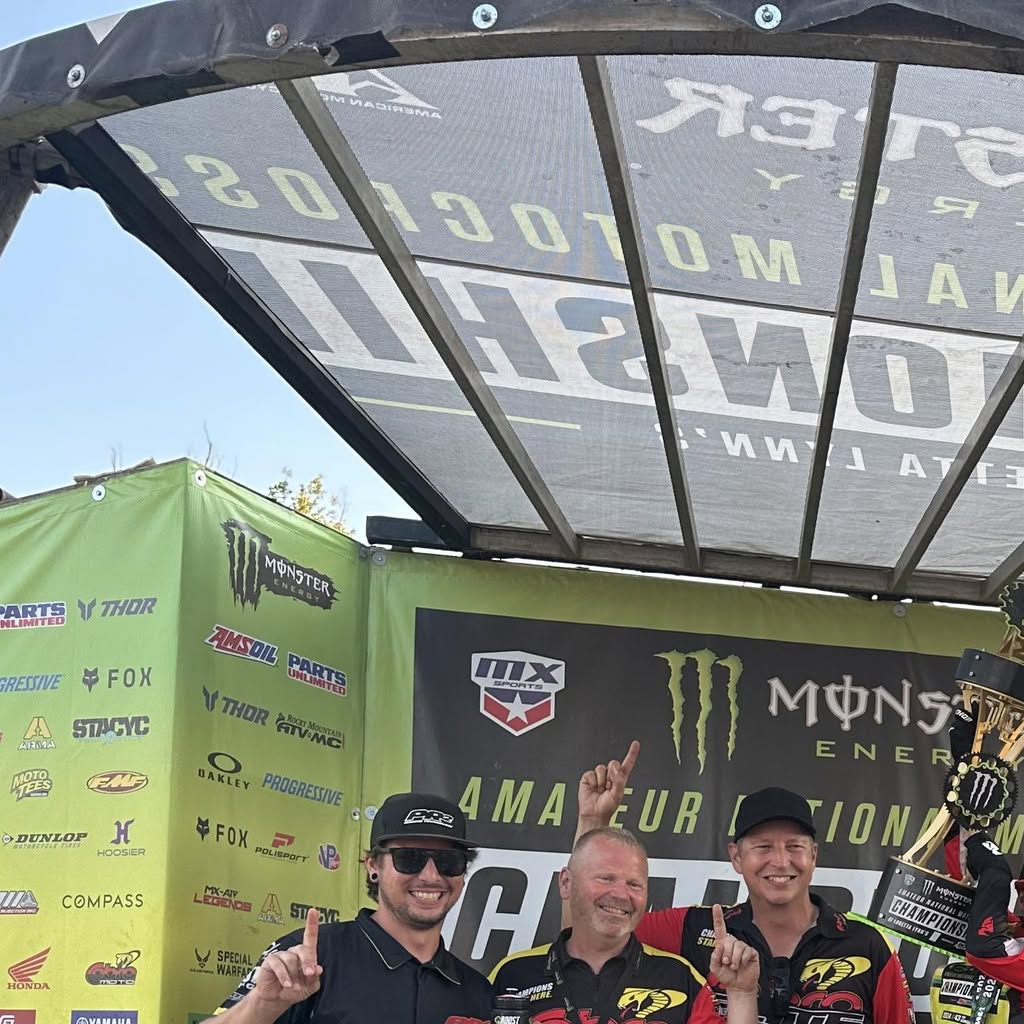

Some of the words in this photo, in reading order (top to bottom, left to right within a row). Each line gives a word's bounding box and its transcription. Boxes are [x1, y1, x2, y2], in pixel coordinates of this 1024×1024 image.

[264, 554, 331, 597] MONSTER
[273, 578, 321, 602] ENERGY
[101, 597, 158, 617] THOR
[0, 615, 66, 629] NLIMITED
[208, 625, 278, 665] AMSOIL
[107, 667, 152, 689] FOX
[288, 652, 348, 687] PARTS
[474, 656, 562, 686] MX
[288, 667, 347, 697] UNLIMITED
[493, 678, 544, 690] SPORTS
[222, 696, 270, 726] THOR
[72, 715, 150, 740] STACYC
[12, 768, 49, 789] MOTO
[14, 777, 53, 801] TEES
[90, 773, 148, 791] FMF
[198, 768, 251, 791] OAKLEY
[261, 772, 344, 808] PROGRESSIVE
[458, 776, 704, 835] AMAEUR
[15, 832, 88, 845] DUNLOP
[216, 824, 248, 848] FOX
[97, 847, 146, 857] HOOSIER
[255, 846, 310, 864] POLISPORT
[318, 844, 338, 866] VP
[62, 893, 144, 910] COMPASS
[204, 884, 239, 899] MX-ATV
[193, 892, 252, 913] LEGENDS
[891, 899, 969, 940] CHAMPIONS
[217, 950, 253, 966] SPECIAL
[217, 963, 255, 979] WARFA
[7, 981, 51, 991] HONDA
[99, 978, 136, 986] MOTO
[529, 990, 553, 1002] HERE.
